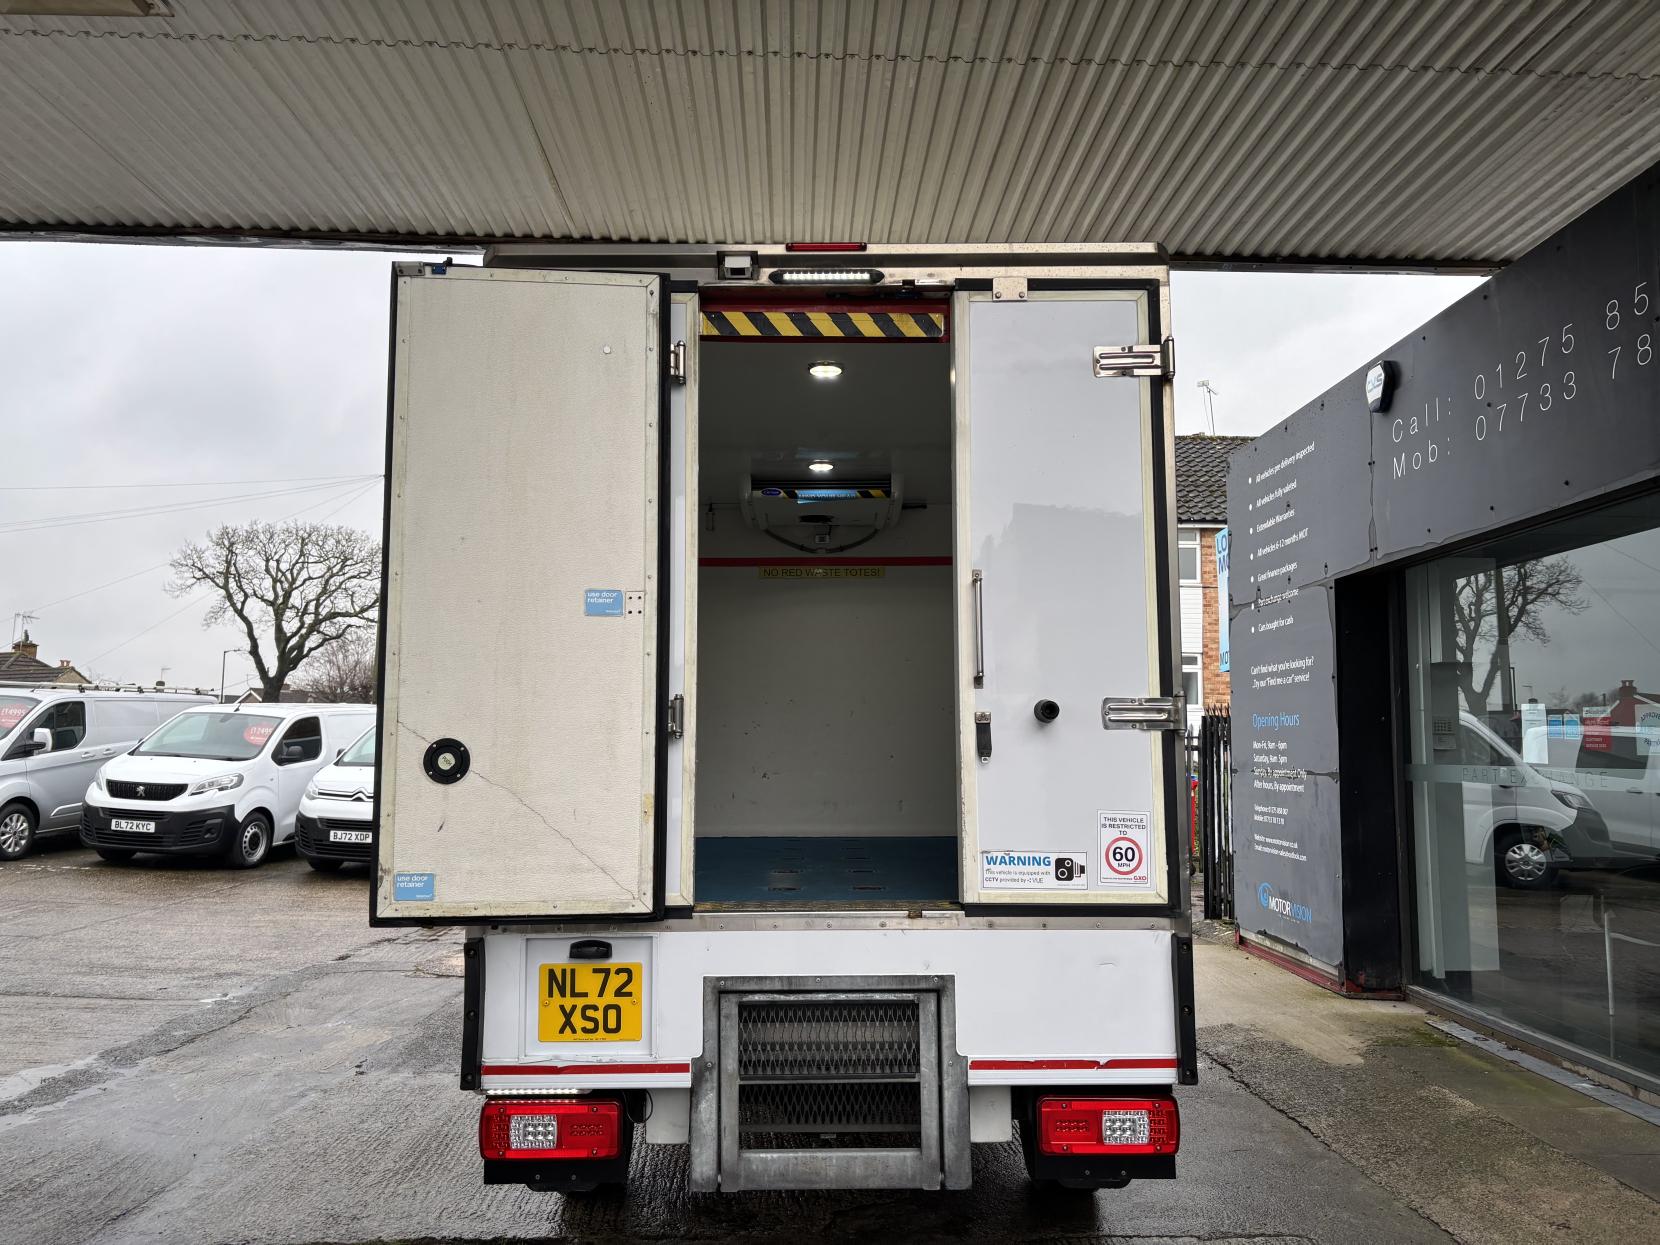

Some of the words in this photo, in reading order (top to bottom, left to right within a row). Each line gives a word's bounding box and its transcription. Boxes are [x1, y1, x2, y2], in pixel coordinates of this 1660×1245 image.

[1392, 396, 1452, 443] Call:
[1474, 323, 1576, 400] 01275
[1393, 437, 1452, 480] Mob:
[1475, 371, 1577, 441] 07733
[1281, 455, 1295, 469] delivery
[1296, 441, 1315, 460] inspected
[763, 568, 780, 577] NO
[782, 568, 803, 577] RED
[806, 568, 841, 577] WASTE
[845, 568, 881, 577] TOTES!
[1269, 663, 1278, 673] what
[1290, 659, 1306, 670] looking
[1306, 656, 1315, 667] for?
[1294, 672, 1310, 683] service!
[1252, 713, 1279, 731] Opening
[1280, 712, 1301, 727] Hours
[1463, 768, 1498, 782] PART
[1279, 783, 1305, 793] appointment
[114, 822, 134, 832] BL72
[135, 822, 155, 832] KYC
[333, 832, 353, 842] BJ72
[353, 832, 371, 843] XDP
[986, 855, 1052, 867] WARNING
[1113, 847, 1136, 863] 60
[411, 874, 429, 882] door
[1269, 896, 1312, 924] MOTORVISION
[548, 968, 634, 999] NL72
[558, 1004, 622, 1035] XSO
